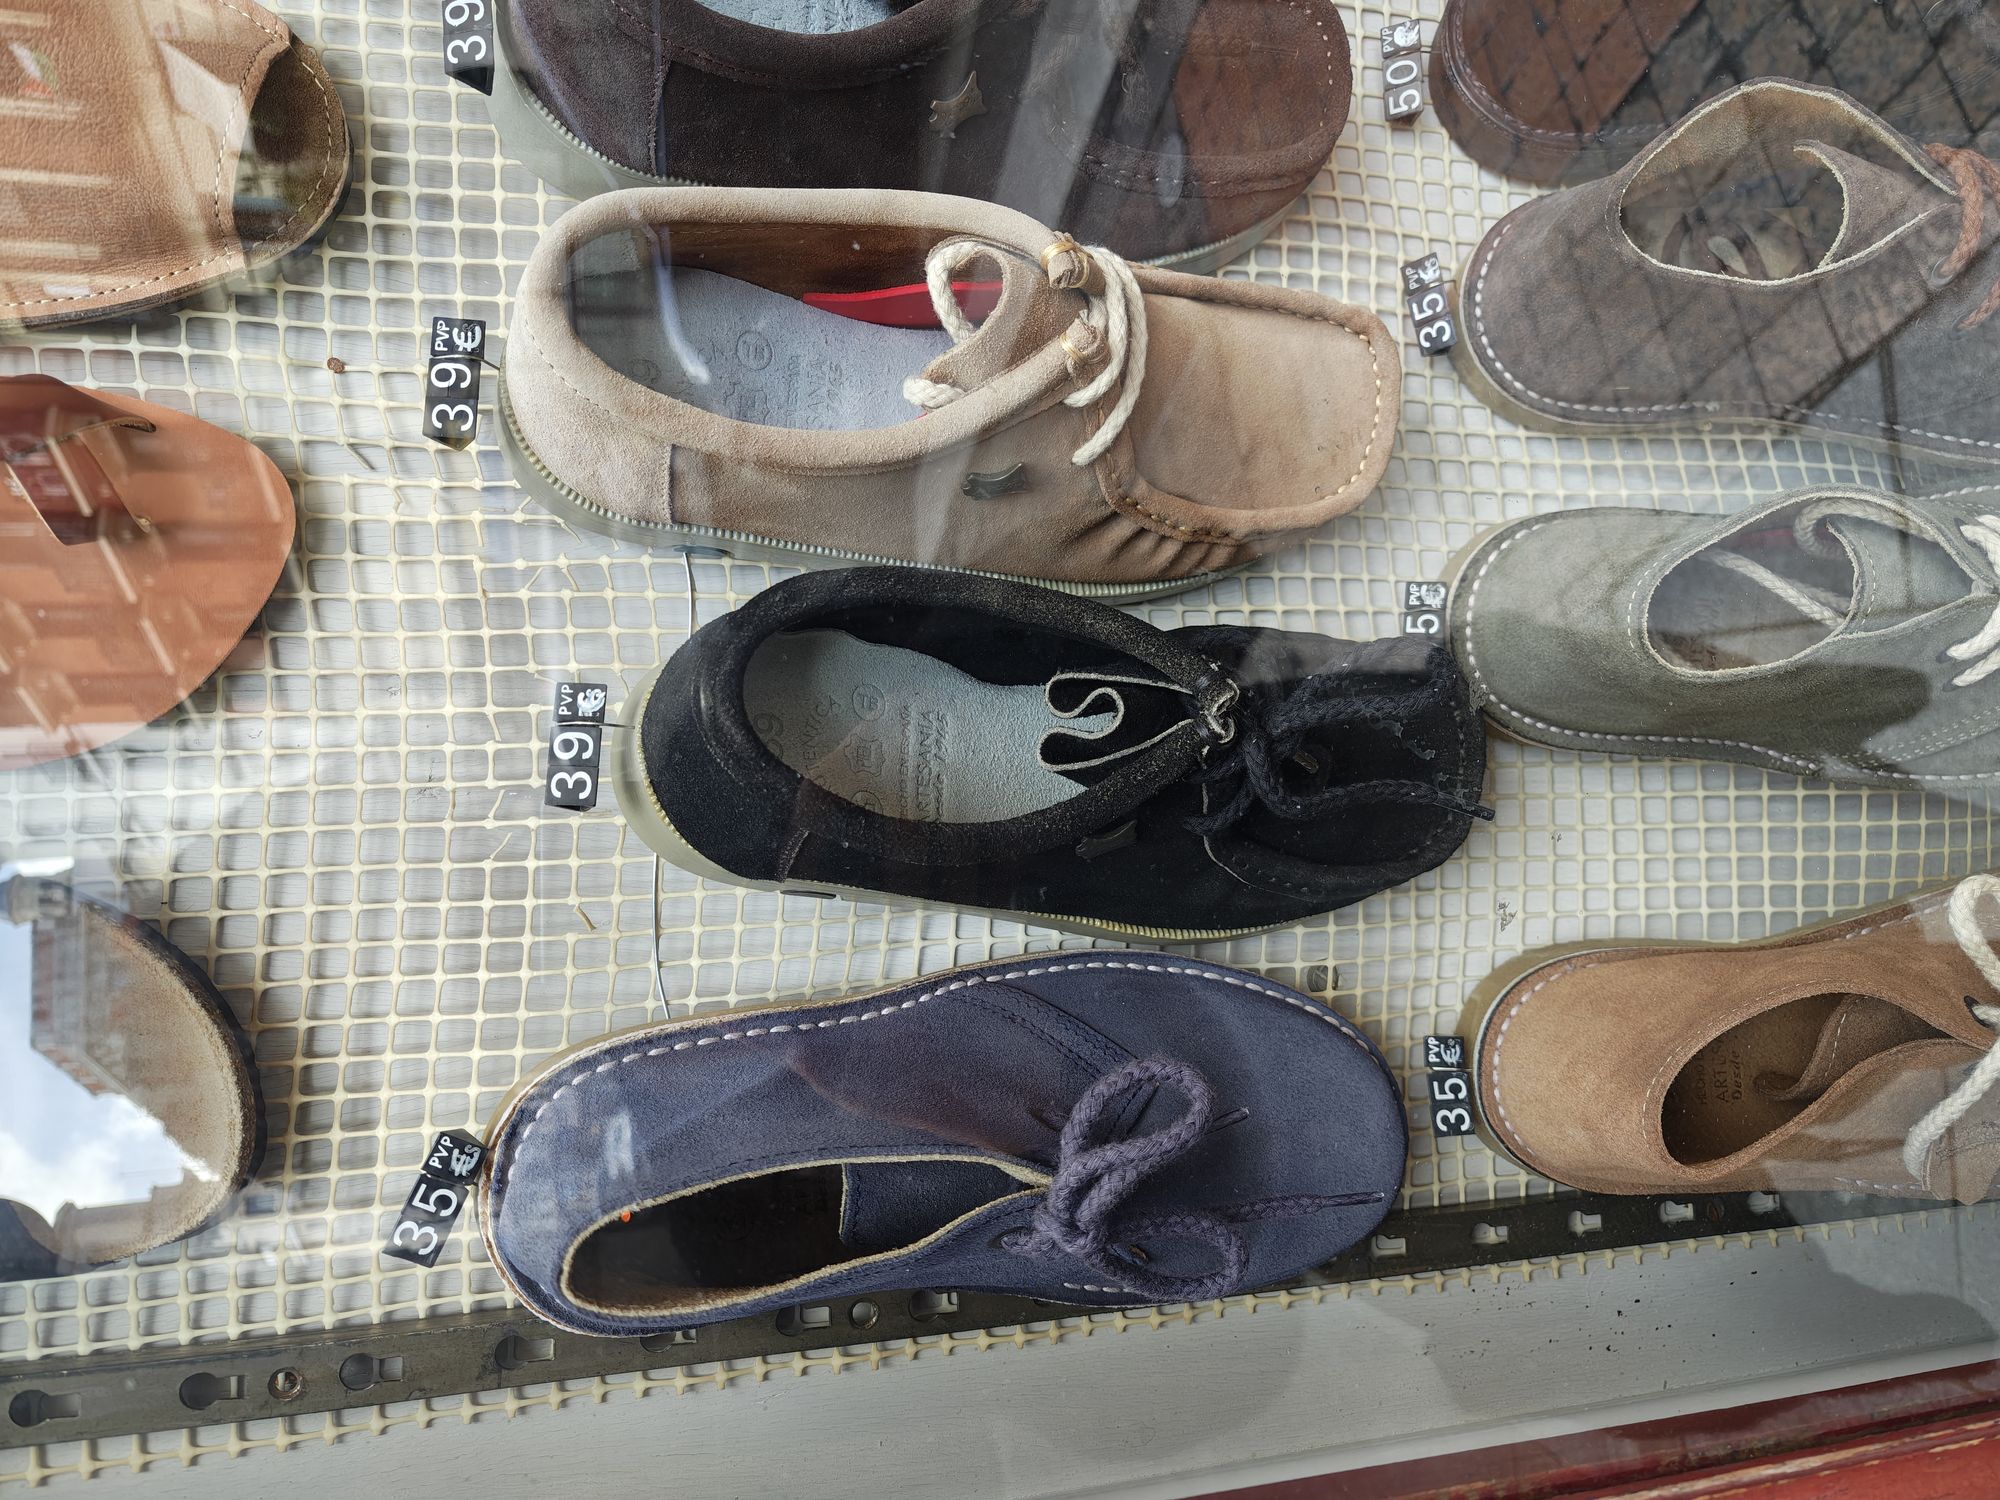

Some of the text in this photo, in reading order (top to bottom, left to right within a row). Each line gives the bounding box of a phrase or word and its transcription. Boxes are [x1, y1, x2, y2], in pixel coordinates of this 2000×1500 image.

[445, 0, 487, 64] 39
[1382, 27, 1395, 53] PVP
[1385, 59, 1420, 115] 50
[1405, 267, 1421, 290] PVP
[434, 320, 451, 351] PVP
[1411, 292, 1452, 348] 35
[430, 362, 474, 431] 39
[1408, 583, 1421, 606] PVP
[558, 684, 574, 716] PVP
[550, 731, 594, 800] 39
[1427, 1036, 1441, 1063] PVP
[1432, 1077, 1471, 1131] 35
[428, 1135, 454, 1169] PVP
[392, 1184, 458, 1255] 35
